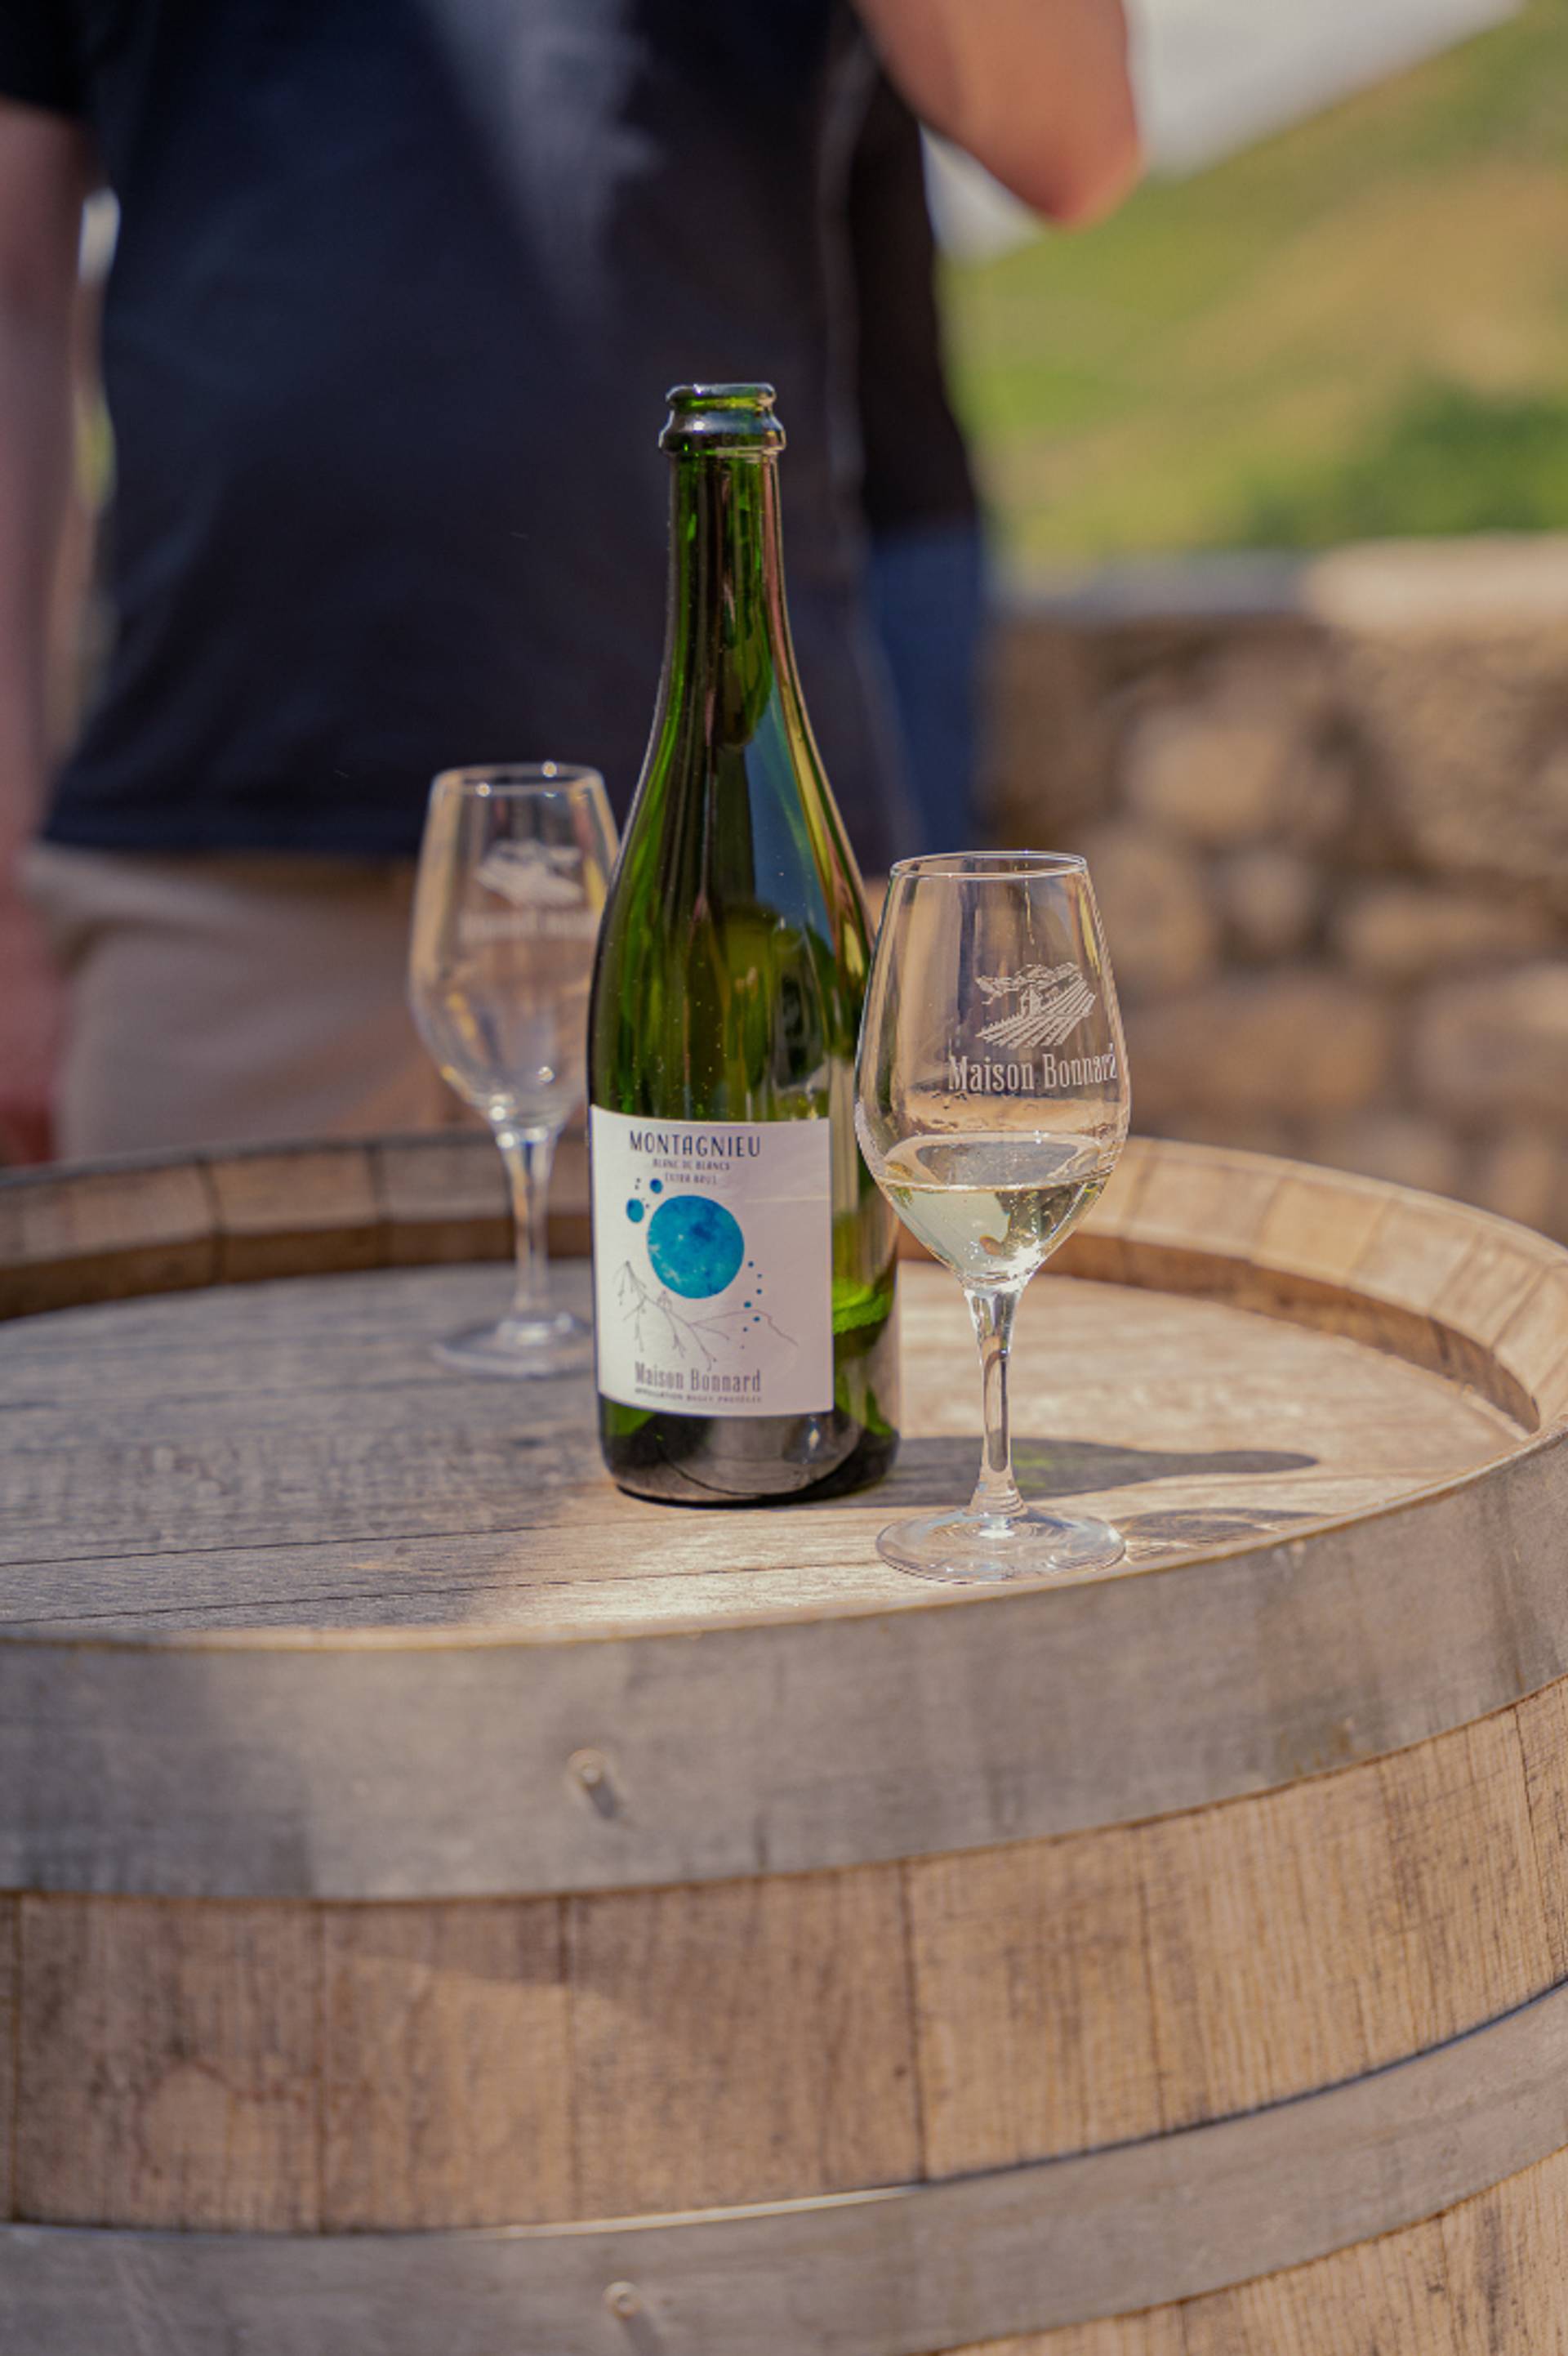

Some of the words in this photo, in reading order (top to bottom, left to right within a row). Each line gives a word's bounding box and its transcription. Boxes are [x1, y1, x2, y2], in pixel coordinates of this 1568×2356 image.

[948, 1052, 1035, 1091] Maison
[1042, 1043, 1118, 1089] Bonnard
[630, 1130, 760, 1158] MONTAGNIEU
[635, 1361, 684, 1390] Maison
[691, 1368, 761, 1393] Bonnard
